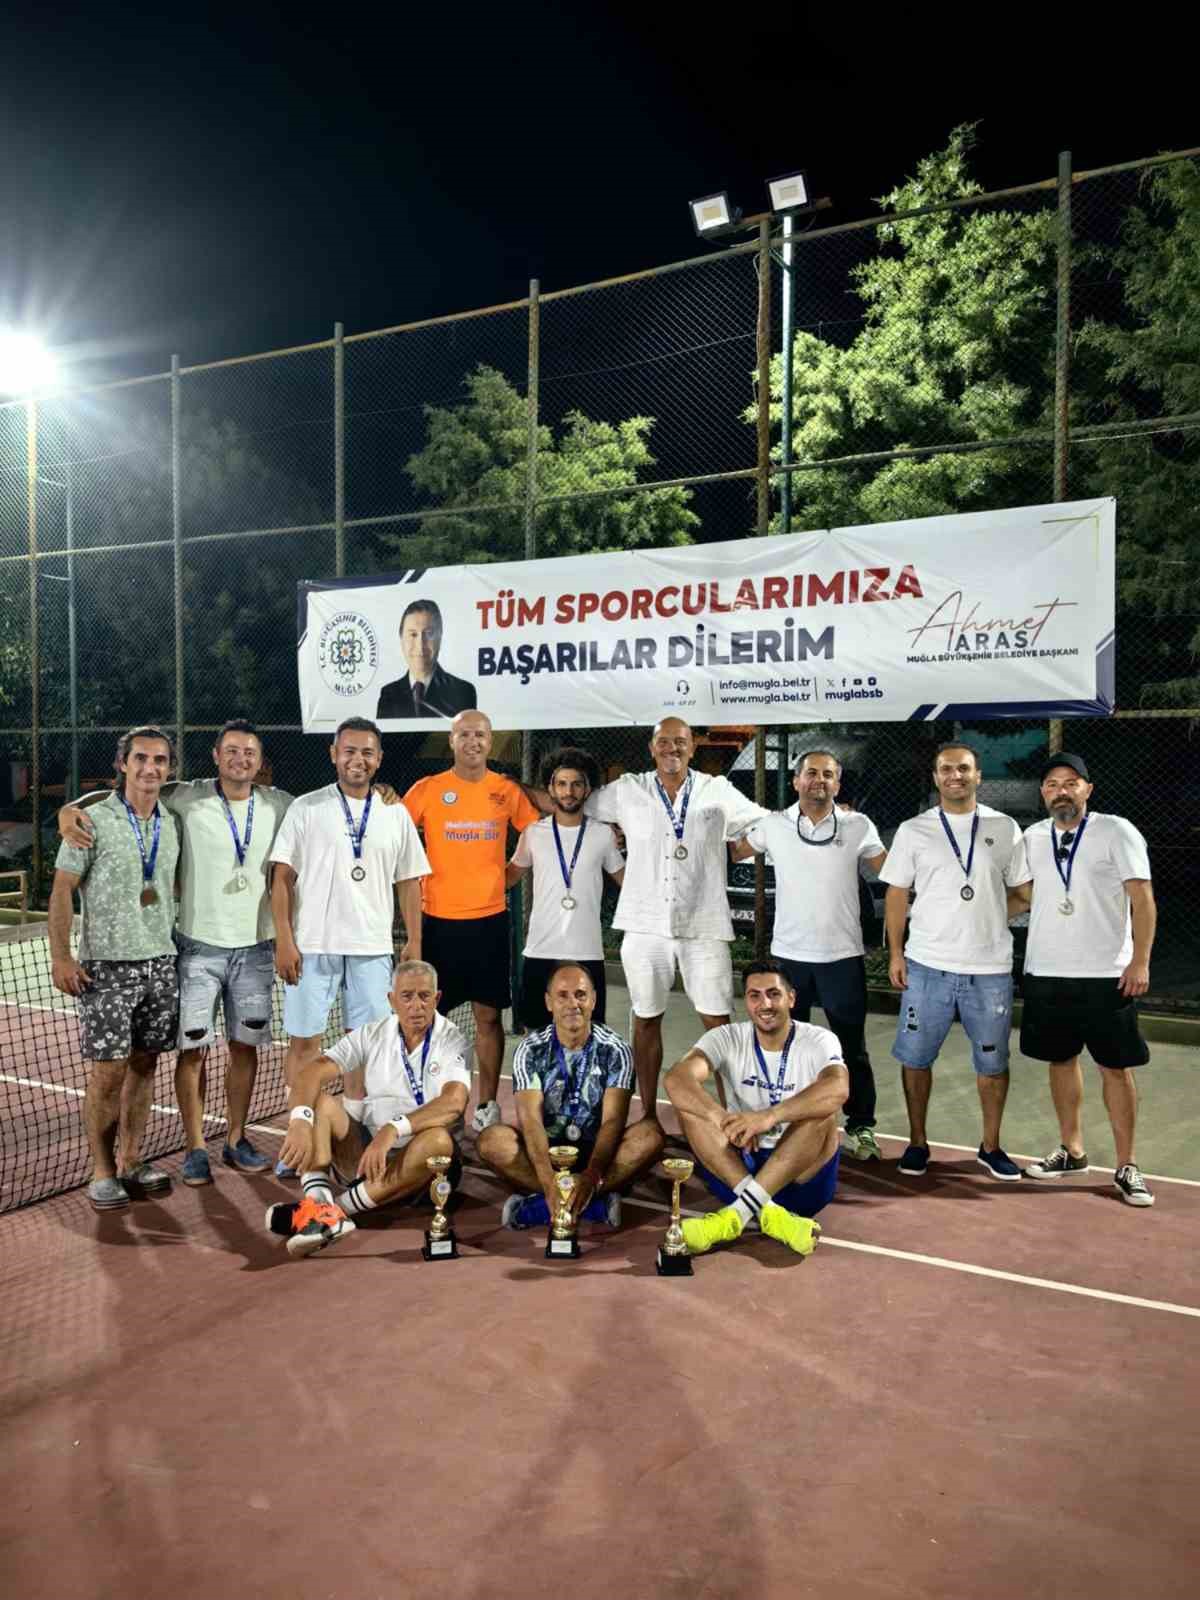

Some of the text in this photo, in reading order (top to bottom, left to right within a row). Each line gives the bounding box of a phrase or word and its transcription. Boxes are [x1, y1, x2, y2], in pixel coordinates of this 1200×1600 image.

[476, 564, 924, 630] TÜM SPORCULARIMIZA
[906, 591, 1078, 651] Ahmet
[954, 630, 1028, 652] ARAS
[477, 617, 835, 685] BAŞARILAR DİLERİM
[906, 647, 1079, 663] MUĞLA BÜYÜKŞEHİR BELEDİYE BAŞKANI
[719, 678, 811, 691] info@mugla.bel.tr
[720, 691, 811, 704] www.mugla.bel.tr
[825, 688, 884, 701] muglabsb
